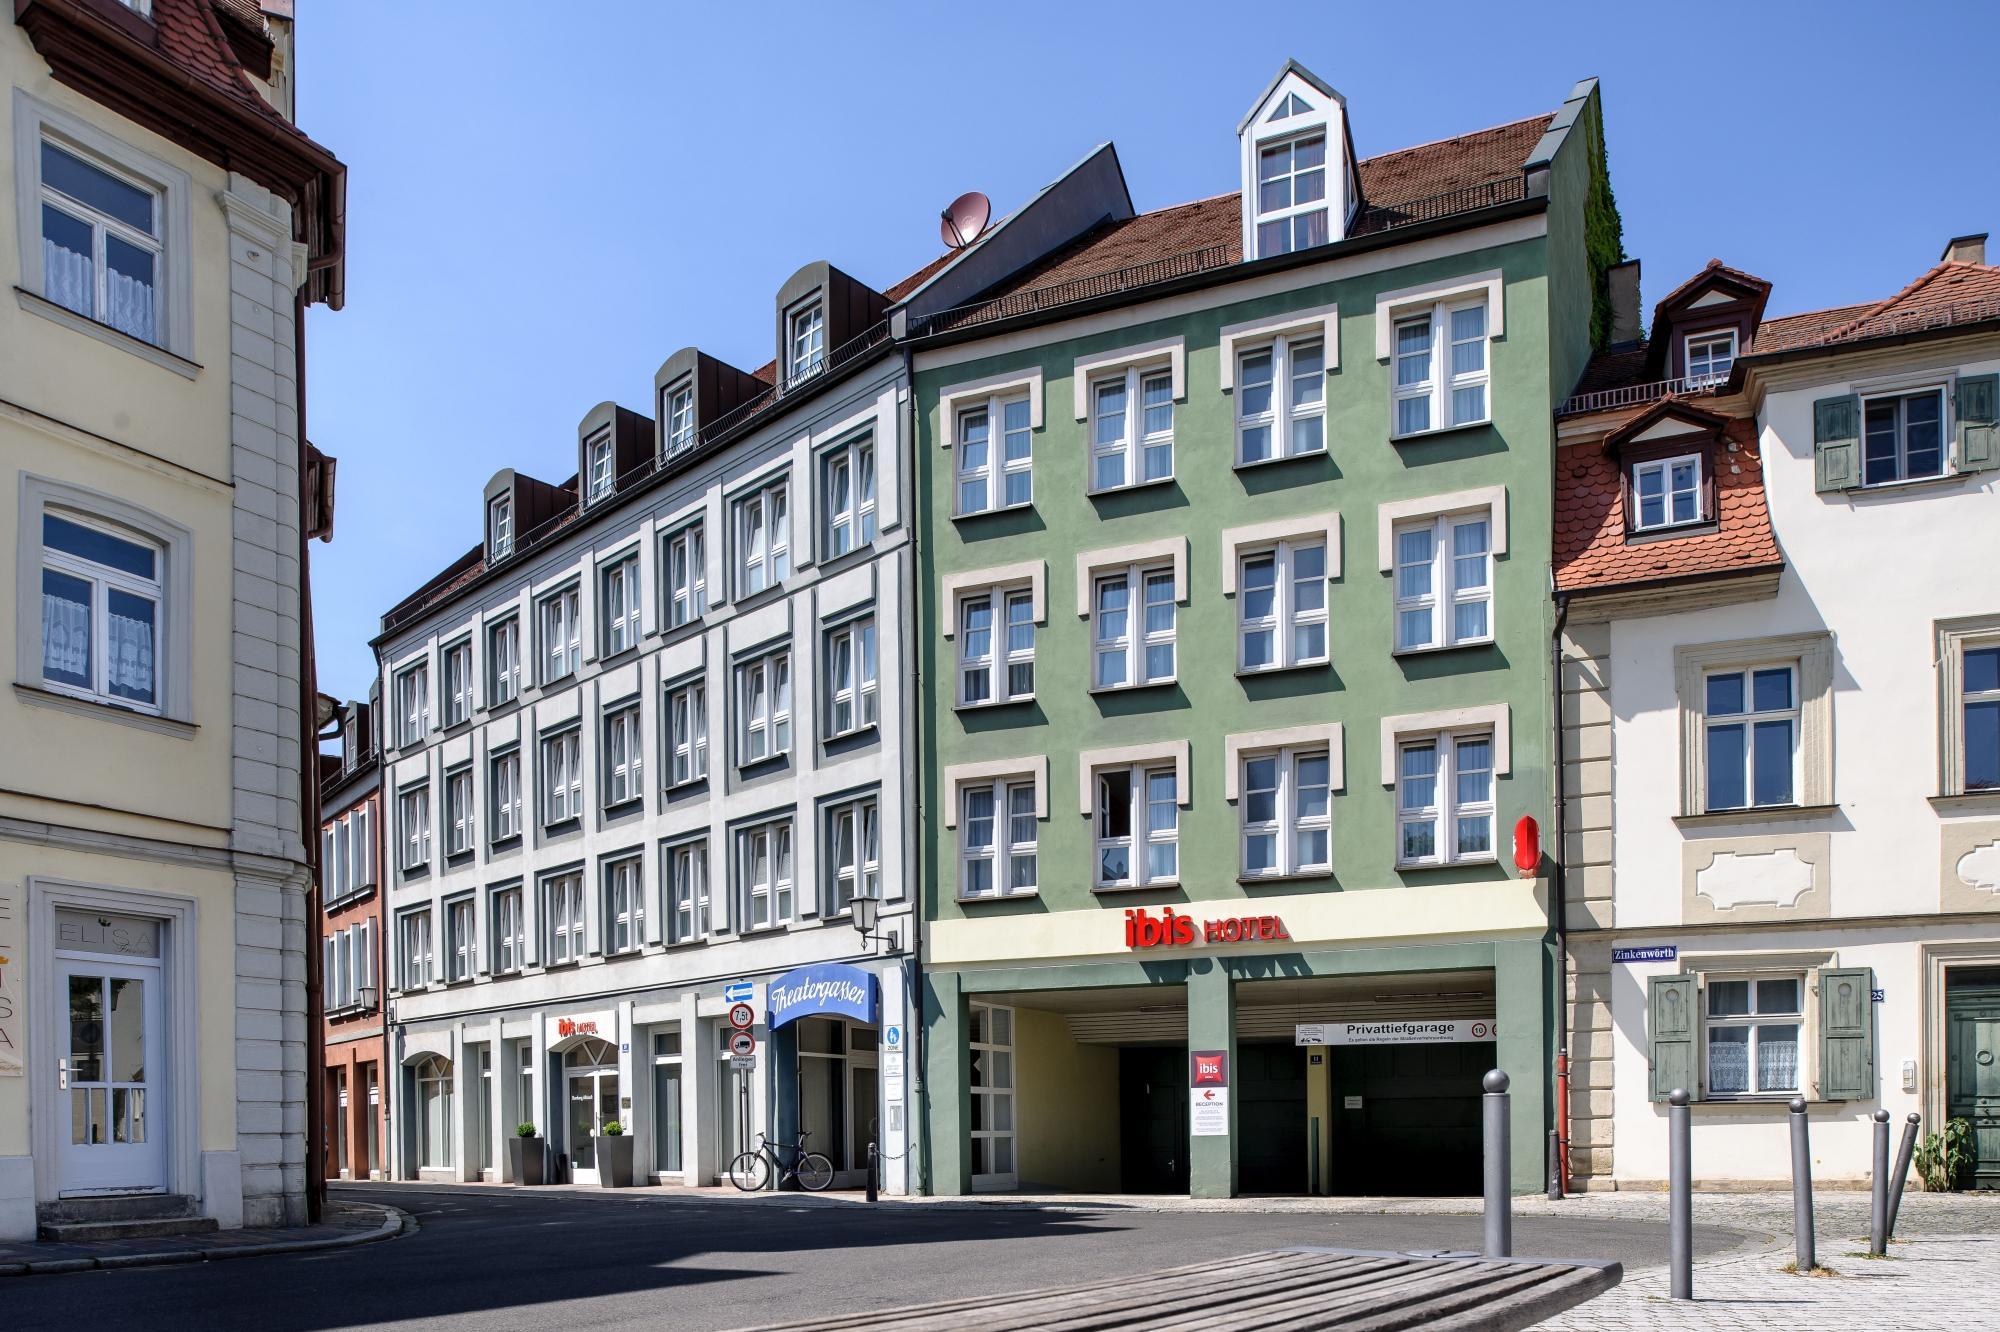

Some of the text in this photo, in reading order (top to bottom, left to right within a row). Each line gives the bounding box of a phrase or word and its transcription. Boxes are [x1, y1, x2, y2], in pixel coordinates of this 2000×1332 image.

[1125, 907, 1289, 948] ibis HOTEL
[60, 923, 153, 948] ELISA
[1614, 948, 1674, 959] Zinkenwörth
[771, 976, 865, 1016] Theatergassen
[1871, 991, 1883, 1000] 25
[1347, 1023, 1455, 1035] Privattiefgarage
[1199, 1063, 1218, 1074] ibis
